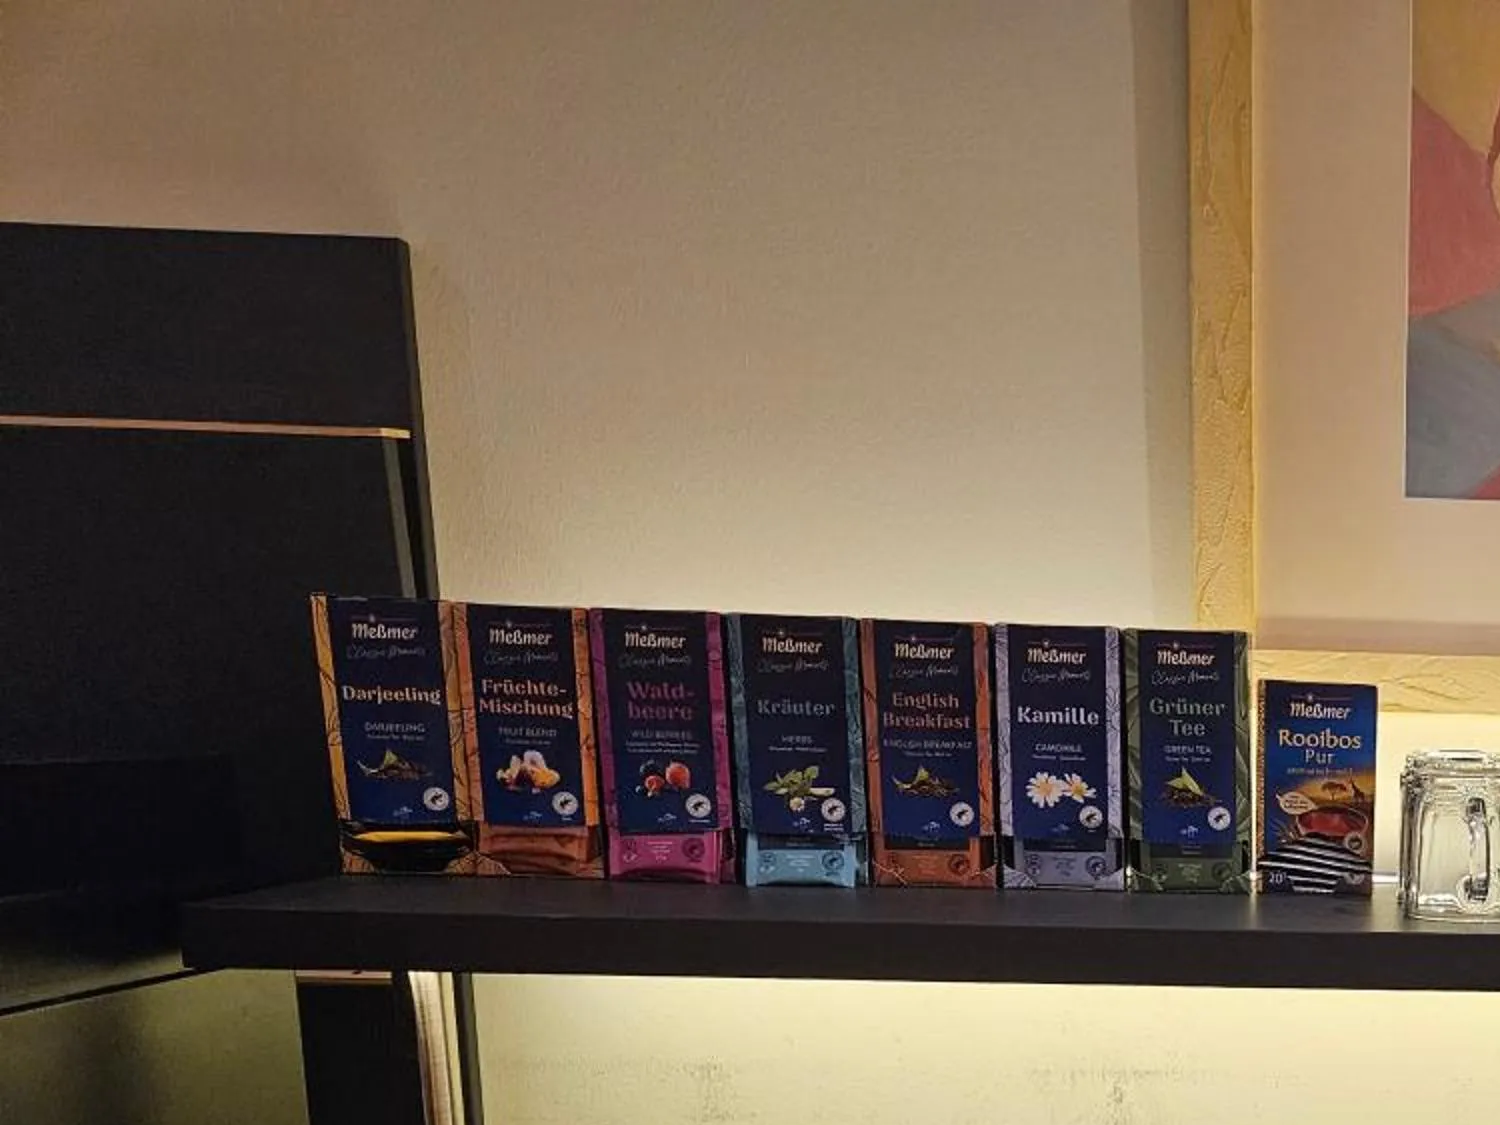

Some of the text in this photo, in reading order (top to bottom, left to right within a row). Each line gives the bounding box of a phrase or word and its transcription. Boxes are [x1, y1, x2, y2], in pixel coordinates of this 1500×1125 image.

[351, 623, 418, 639] Meßmer
[489, 628, 553, 645] Meßmer
[624, 631, 686, 649] Meßmer
[762, 637, 823, 653] Meßmer
[894, 643, 955, 660] Meßmer
[1027, 647, 1087, 665] Meßmer
[1157, 650, 1216, 665] Meßmer
[342, 685, 441, 705] Darjeeling
[482, 679, 567, 696] Früchte-
[626, 681, 695, 700] Wald-
[479, 699, 573, 719] Mischung
[757, 698, 835, 717] Kräuter
[892, 692, 960, 711] English
[1149, 697, 1226, 716] Grüner
[627, 701, 693, 721] beere
[1017, 705, 1099, 725] Kamille
[1290, 702, 1352, 720] Meßmer
[883, 712, 970, 729] Breakfast
[1169, 719, 1206, 737] Tee
[1279, 728, 1362, 750] Rooibos
[1305, 749, 1336, 765] Pur
